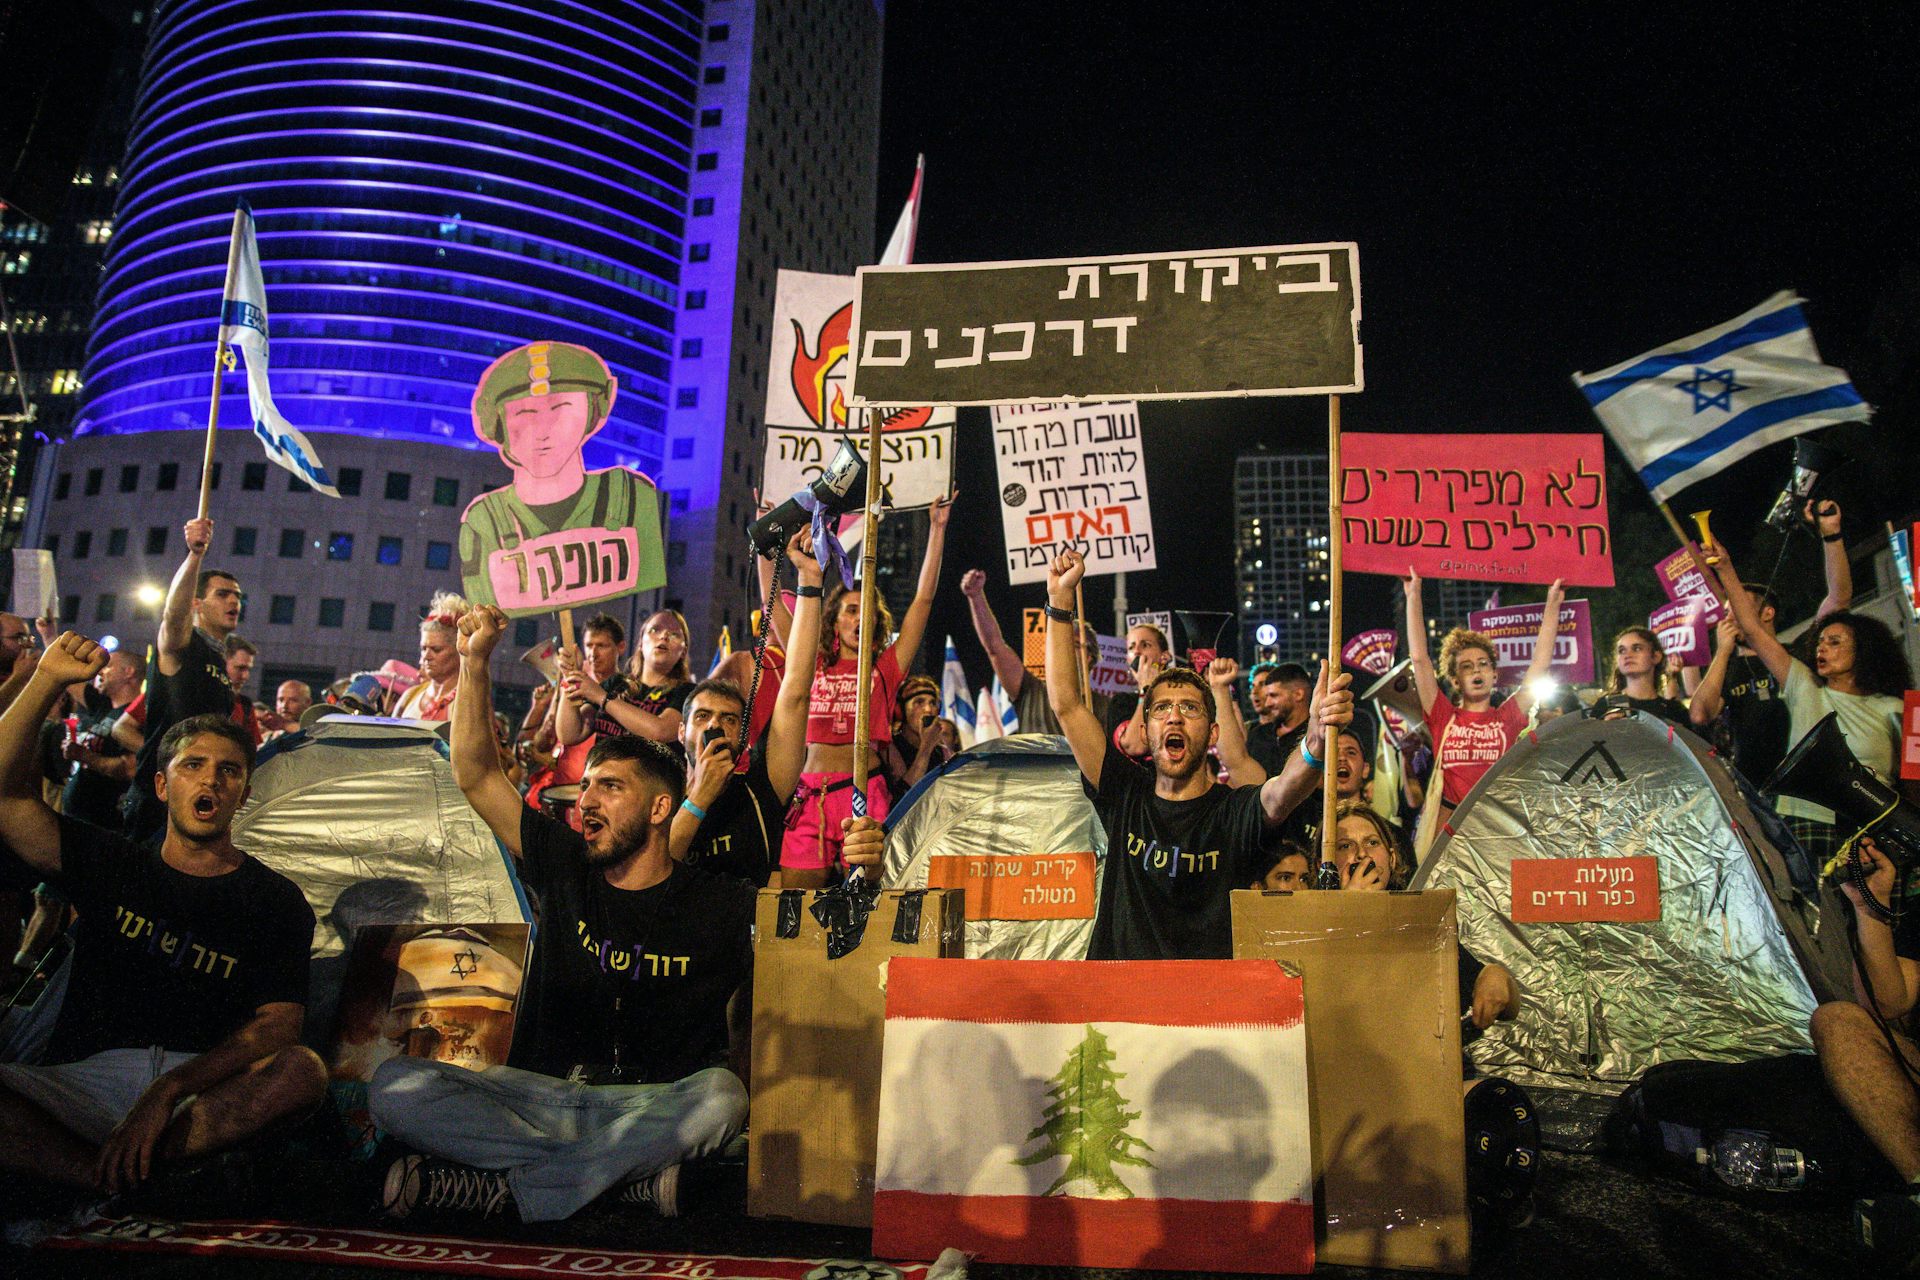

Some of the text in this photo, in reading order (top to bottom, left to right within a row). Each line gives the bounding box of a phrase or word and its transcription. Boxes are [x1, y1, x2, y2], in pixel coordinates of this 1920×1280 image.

[1058, 253, 1339, 303] ביקורת
[859, 316, 1138, 369] דרכנים
[778, 434, 822, 463] מה
[997, 413, 1137, 456] שכח מה זה
[1012, 446, 1138, 484] להיות יהודי
[1029, 481, 1142, 516] ביהדות
[1341, 458, 1603, 513] לא מפקירים
[1025, 504, 1131, 545] האדם
[1344, 510, 1608, 556] חיילים בשטח
[1096, 533, 1150, 563] קודם
[501, 537, 631, 601] הופקר
[1482, 613, 1524, 628] העסקה
[969, 858, 1077, 881] קרית שמונה
[1575, 864, 1635, 888] מעלות
[1022, 884, 1076, 905] מטולה
[1532, 889, 1636, 906] כפר ורדים
[538, 1253, 717, 1279] 100%
